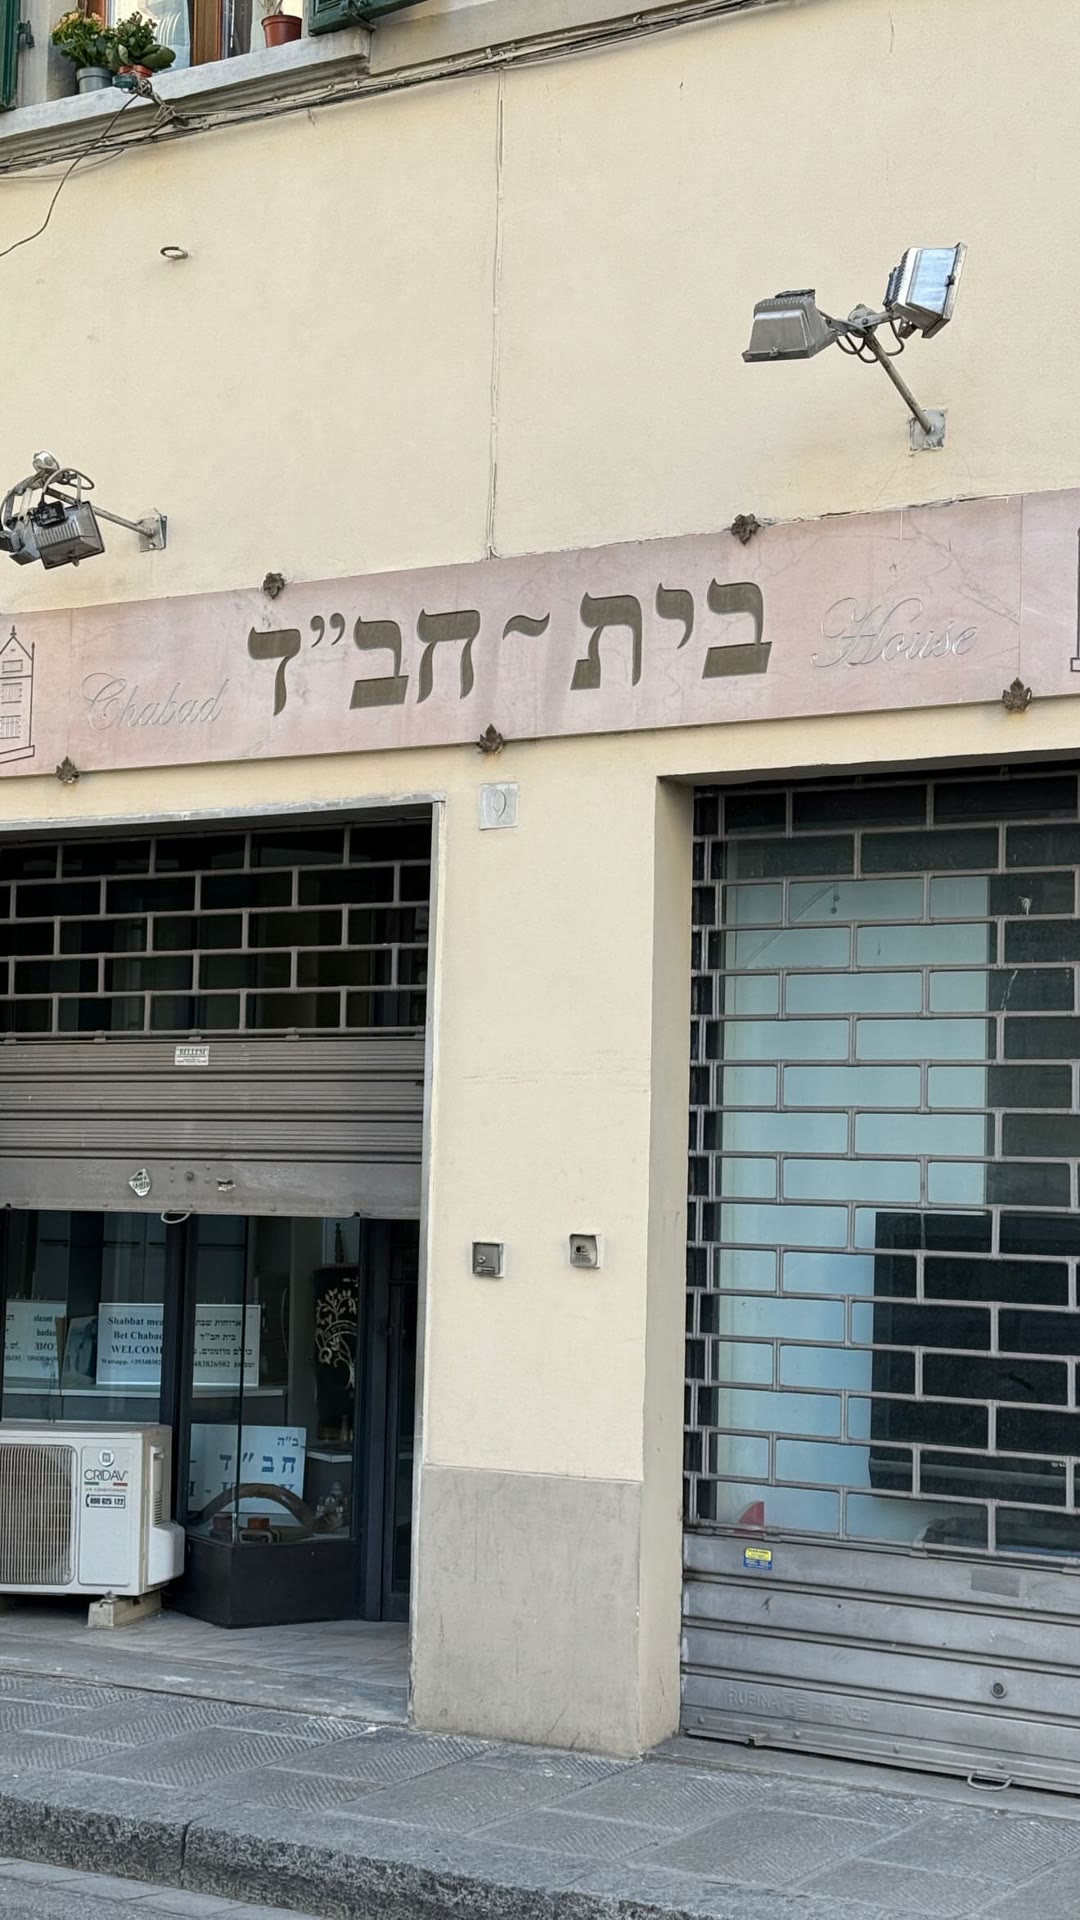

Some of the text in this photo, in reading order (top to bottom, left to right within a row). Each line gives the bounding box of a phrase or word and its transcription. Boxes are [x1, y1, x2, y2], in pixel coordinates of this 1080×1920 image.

[80, 597, 977, 731] Chabad House
[570, 577, 772, 691] בית
[107, 1317, 144, 1326] Shabbat
[114, 1330, 128, 1340] Bet
